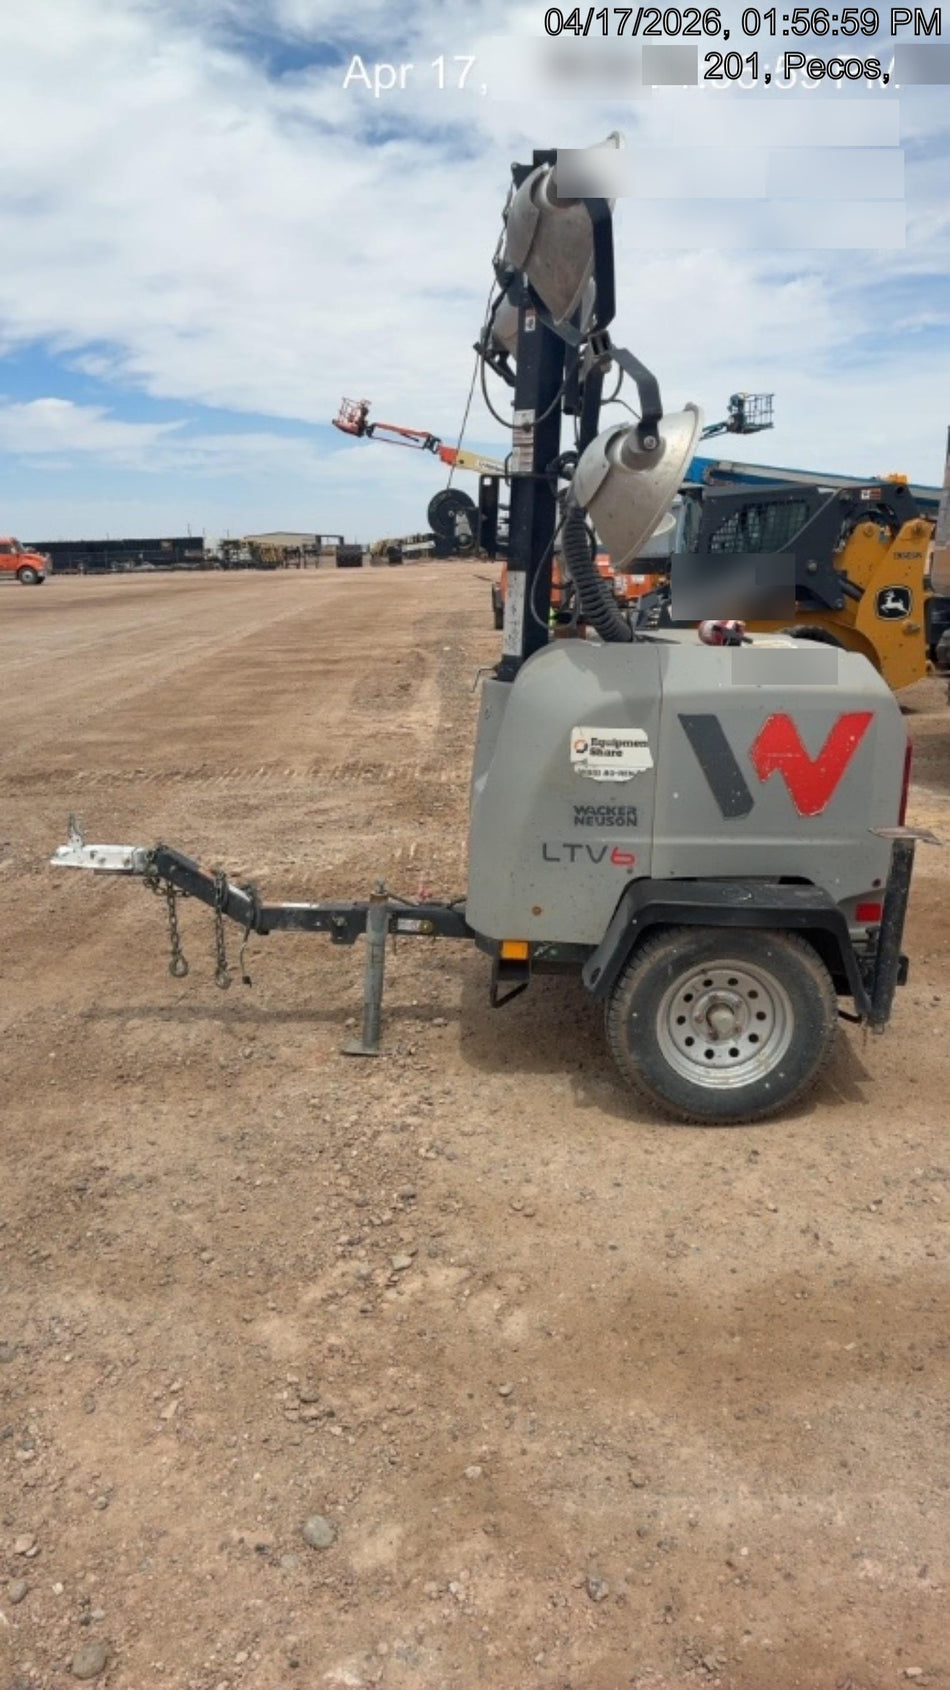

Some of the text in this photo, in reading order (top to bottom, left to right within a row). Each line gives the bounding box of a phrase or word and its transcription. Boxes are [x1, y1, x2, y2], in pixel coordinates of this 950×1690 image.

[573, 805, 637, 816] WACKER
[573, 816, 638, 827] NEUSON
[542, 843, 636, 867] LTV6
